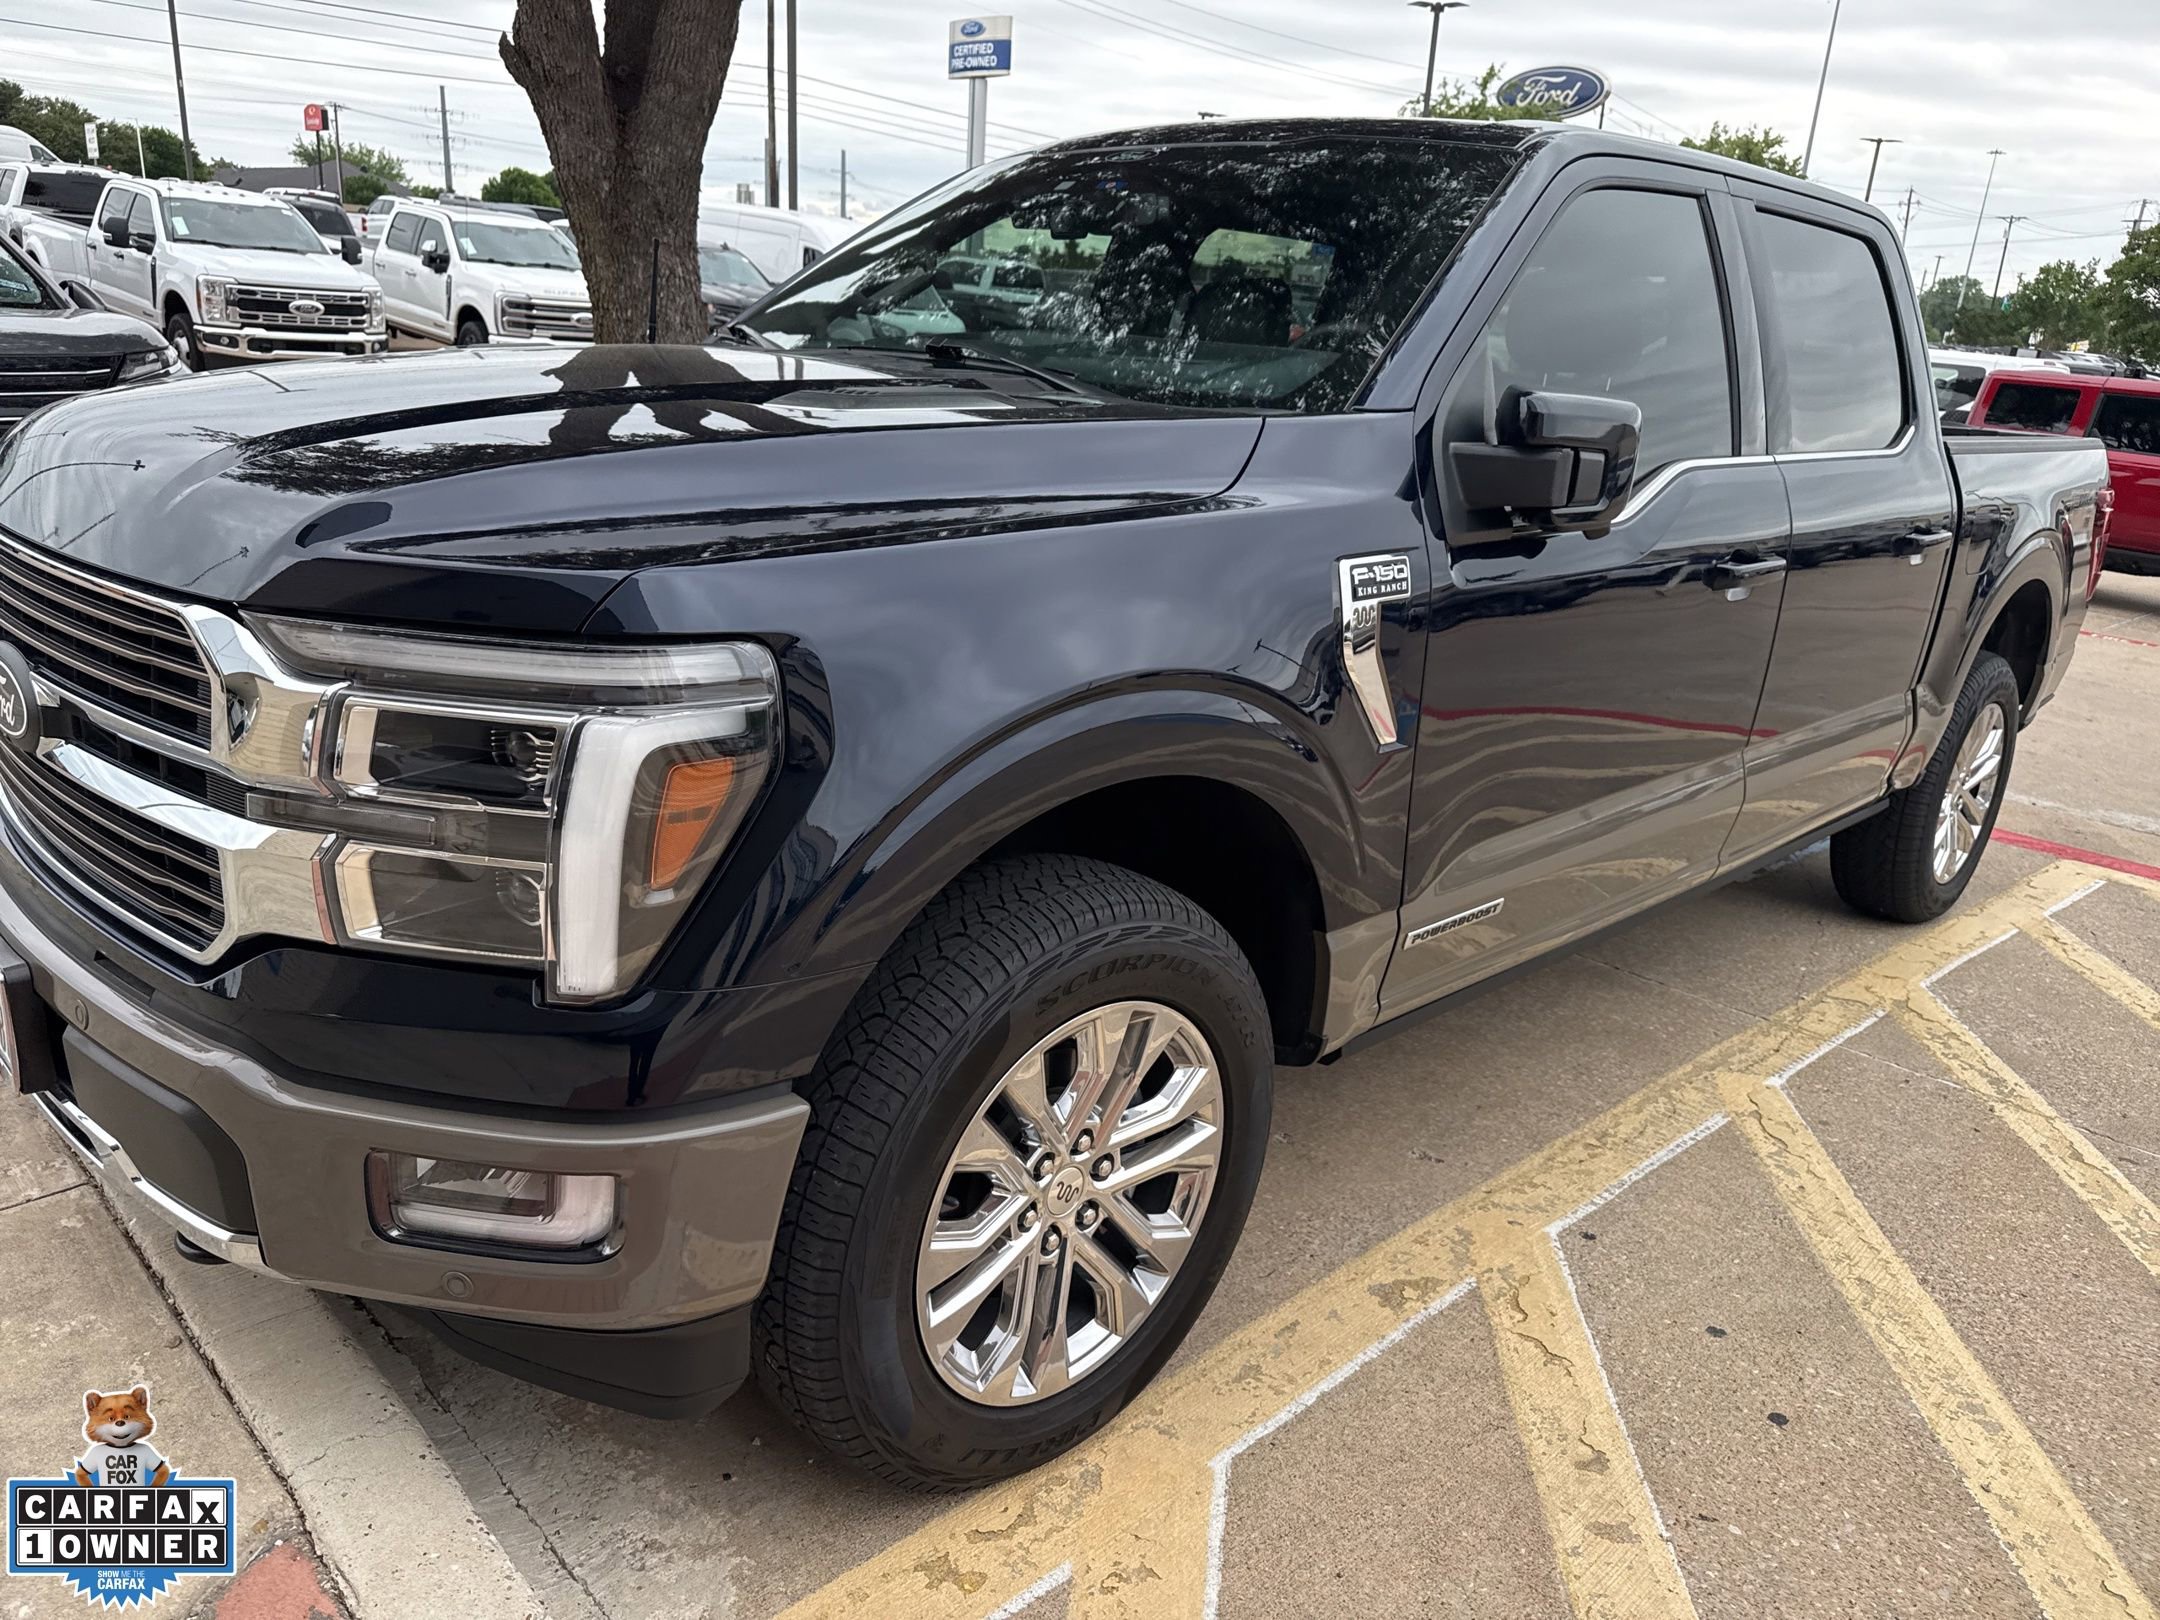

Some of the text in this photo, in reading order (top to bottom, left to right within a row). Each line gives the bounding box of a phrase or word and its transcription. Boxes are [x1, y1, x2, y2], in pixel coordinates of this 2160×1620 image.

[953, 42, 994, 57] CERTIFIED
[951, 55, 998, 70] PRE-OWNED
[1516, 75, 1582, 107] Ford
[1352, 564, 1408, 585] F-150
[1358, 580, 1408, 597] KING RANCH
[1411, 903, 1500, 945] POWERBOOST
[1035, 953, 1219, 1018] SCORPION
